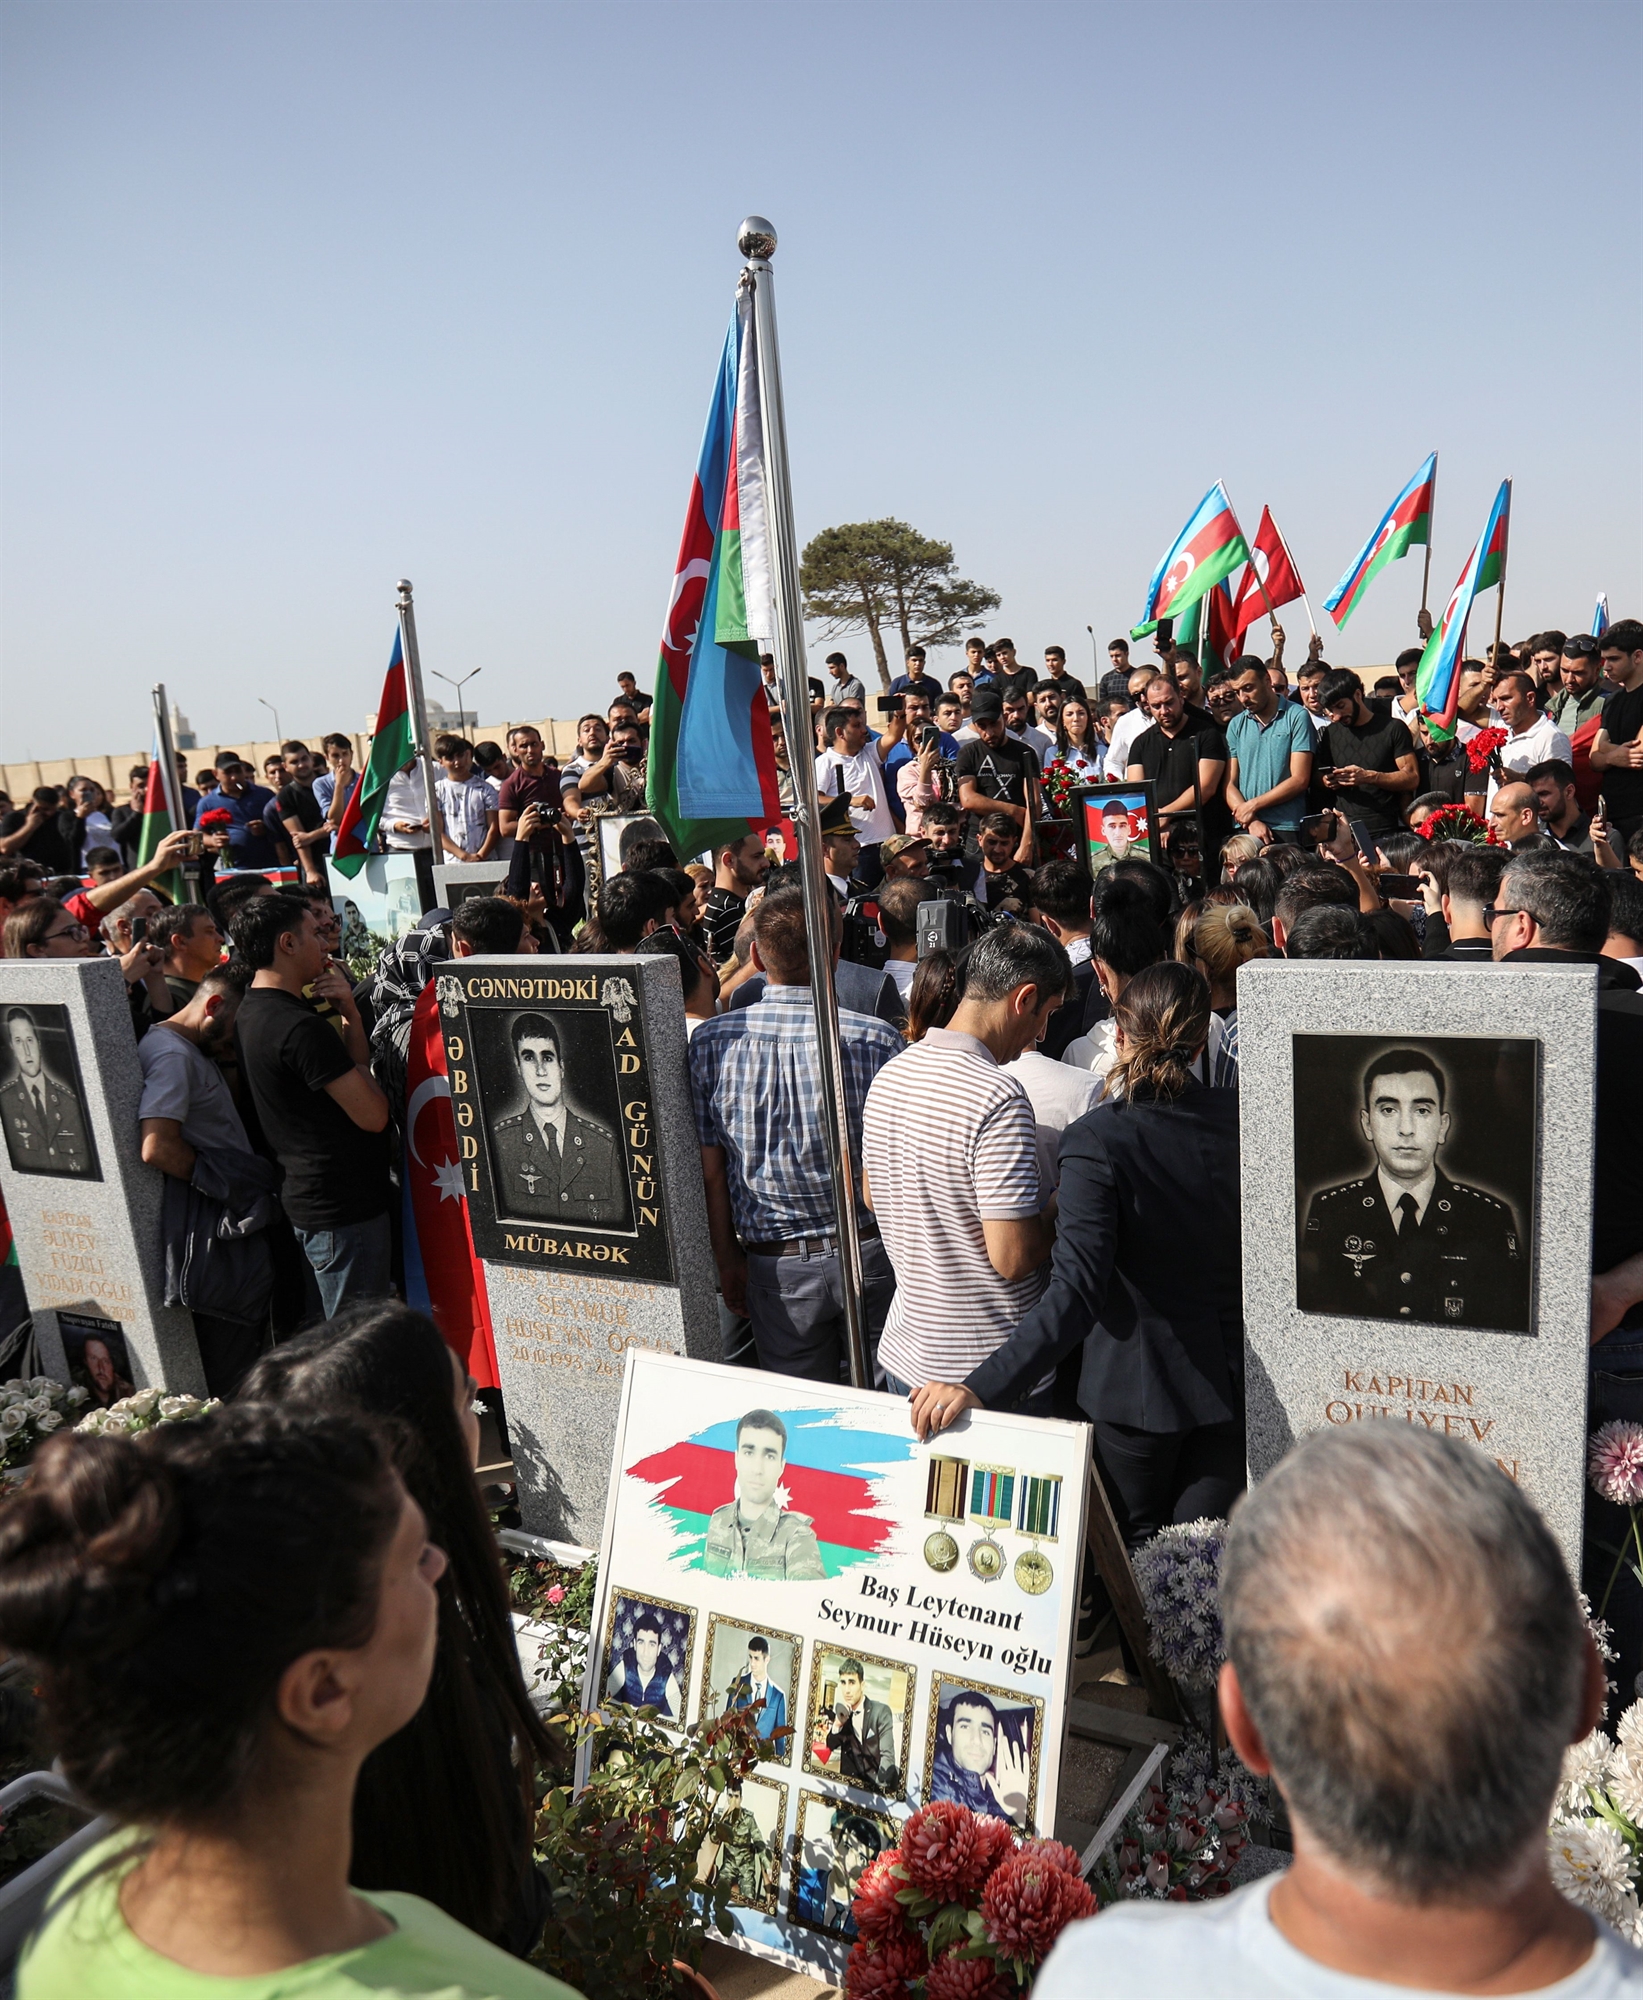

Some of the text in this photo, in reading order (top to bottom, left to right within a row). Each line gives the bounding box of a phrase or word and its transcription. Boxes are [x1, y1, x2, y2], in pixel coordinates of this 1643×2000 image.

[467, 975, 598, 1000] CƏNNƏTDƏKİ
[448, 1036, 479, 1192] ƏBƏDİ
[615, 1027, 660, 1227] AD GÜNÜN
[504, 1233, 630, 1264] MÜBARƏK
[505, 1267, 657, 1301] BAŞ LEYTENANT
[537, 1294, 631, 1328] SEYMUR
[505, 1314, 593, 1349] HÜSEYN
[1344, 1370, 1474, 1406] KAPİTAN
[859, 1574, 1025, 1632] Baş Leytenant
[817, 1597, 1053, 1675] Seymur Hüseyn oğlu
